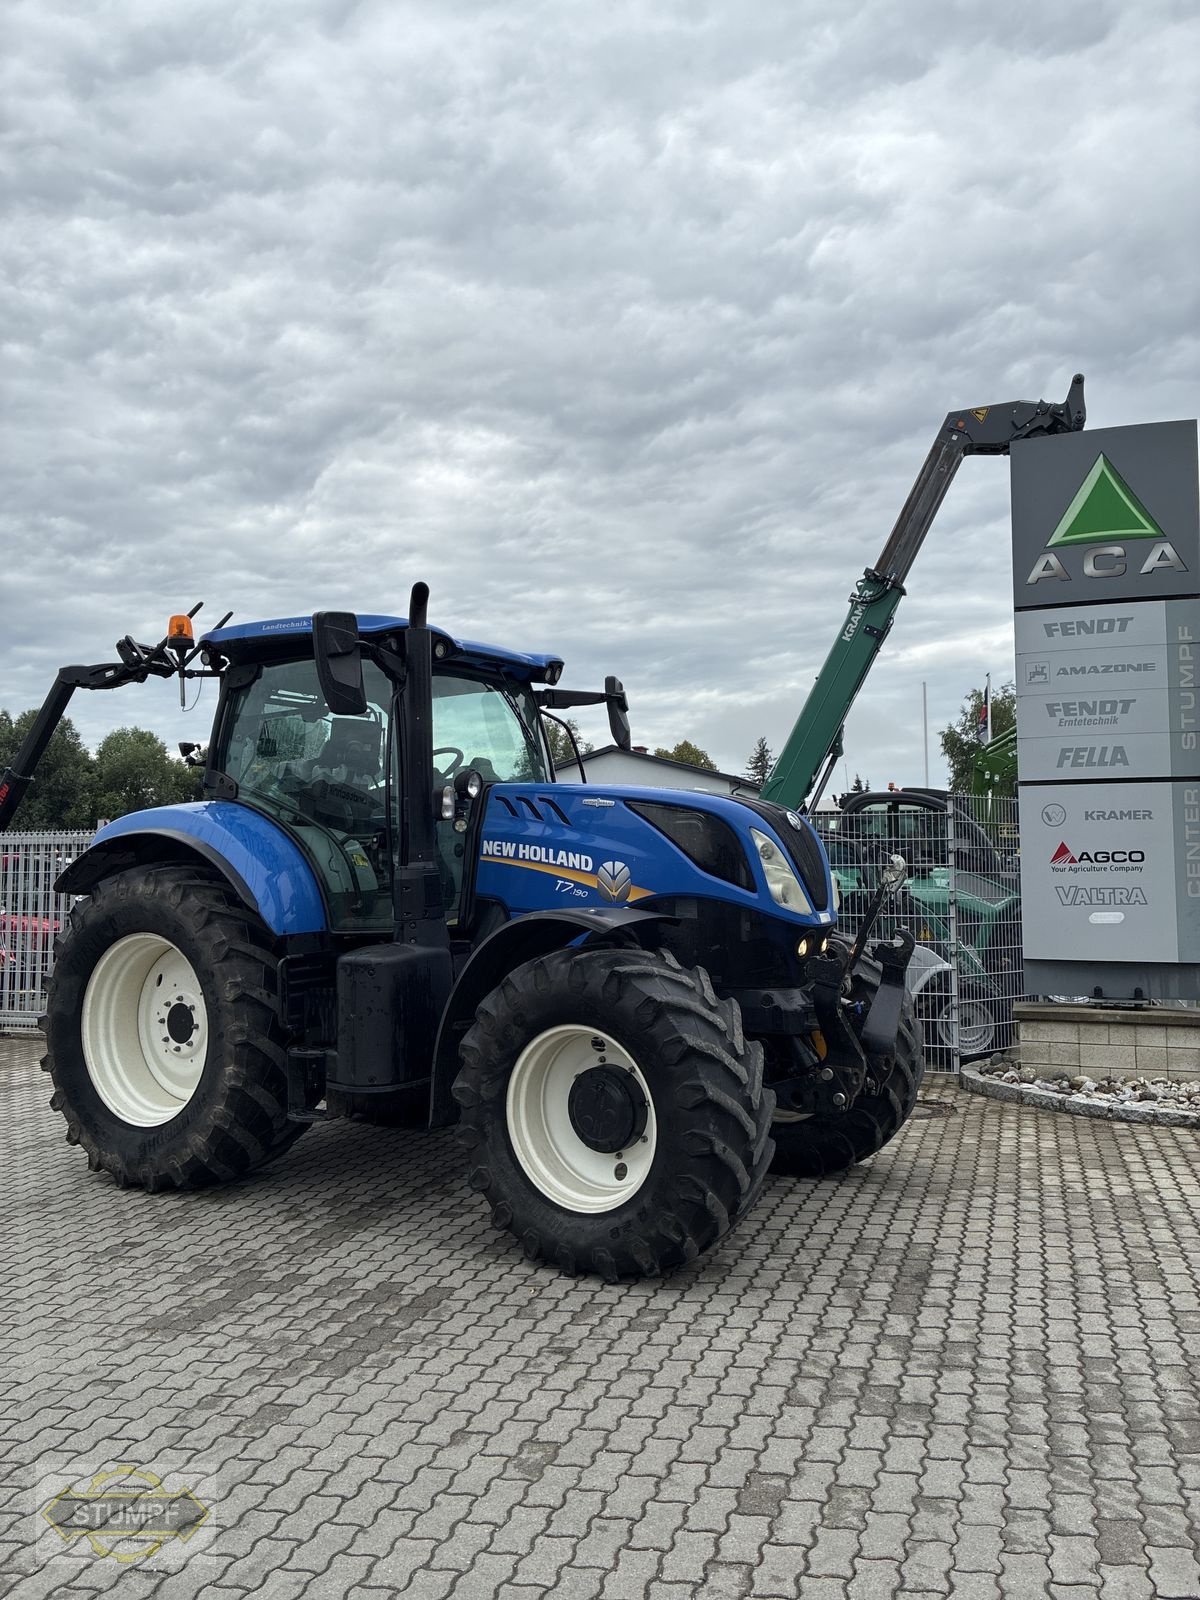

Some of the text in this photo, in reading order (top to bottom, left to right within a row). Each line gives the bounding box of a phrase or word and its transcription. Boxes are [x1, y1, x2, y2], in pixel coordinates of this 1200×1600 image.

[1025, 542, 1189, 585] ACA
[262, 620, 313, 631] Landtechnik-
[1043, 617, 1134, 638] FENDT
[1056, 662, 1156, 676] AMAZONE
[1045, 699, 1136, 717] FENDT
[1058, 715, 1119, 728] Erntetechnik
[1056, 746, 1130, 768] FELLA
[1178, 626, 1200, 898] CENTER STUMPF
[1084, 810, 1154, 821] KRAMER
[483, 840, 593, 872] NEW HOLLAND
[1078, 851, 1145, 864] AGCO
[1068, 865, 1108, 873] Agriculture
[1109, 865, 1143, 873] Company
[1054, 885, 1148, 906] VALTRA
